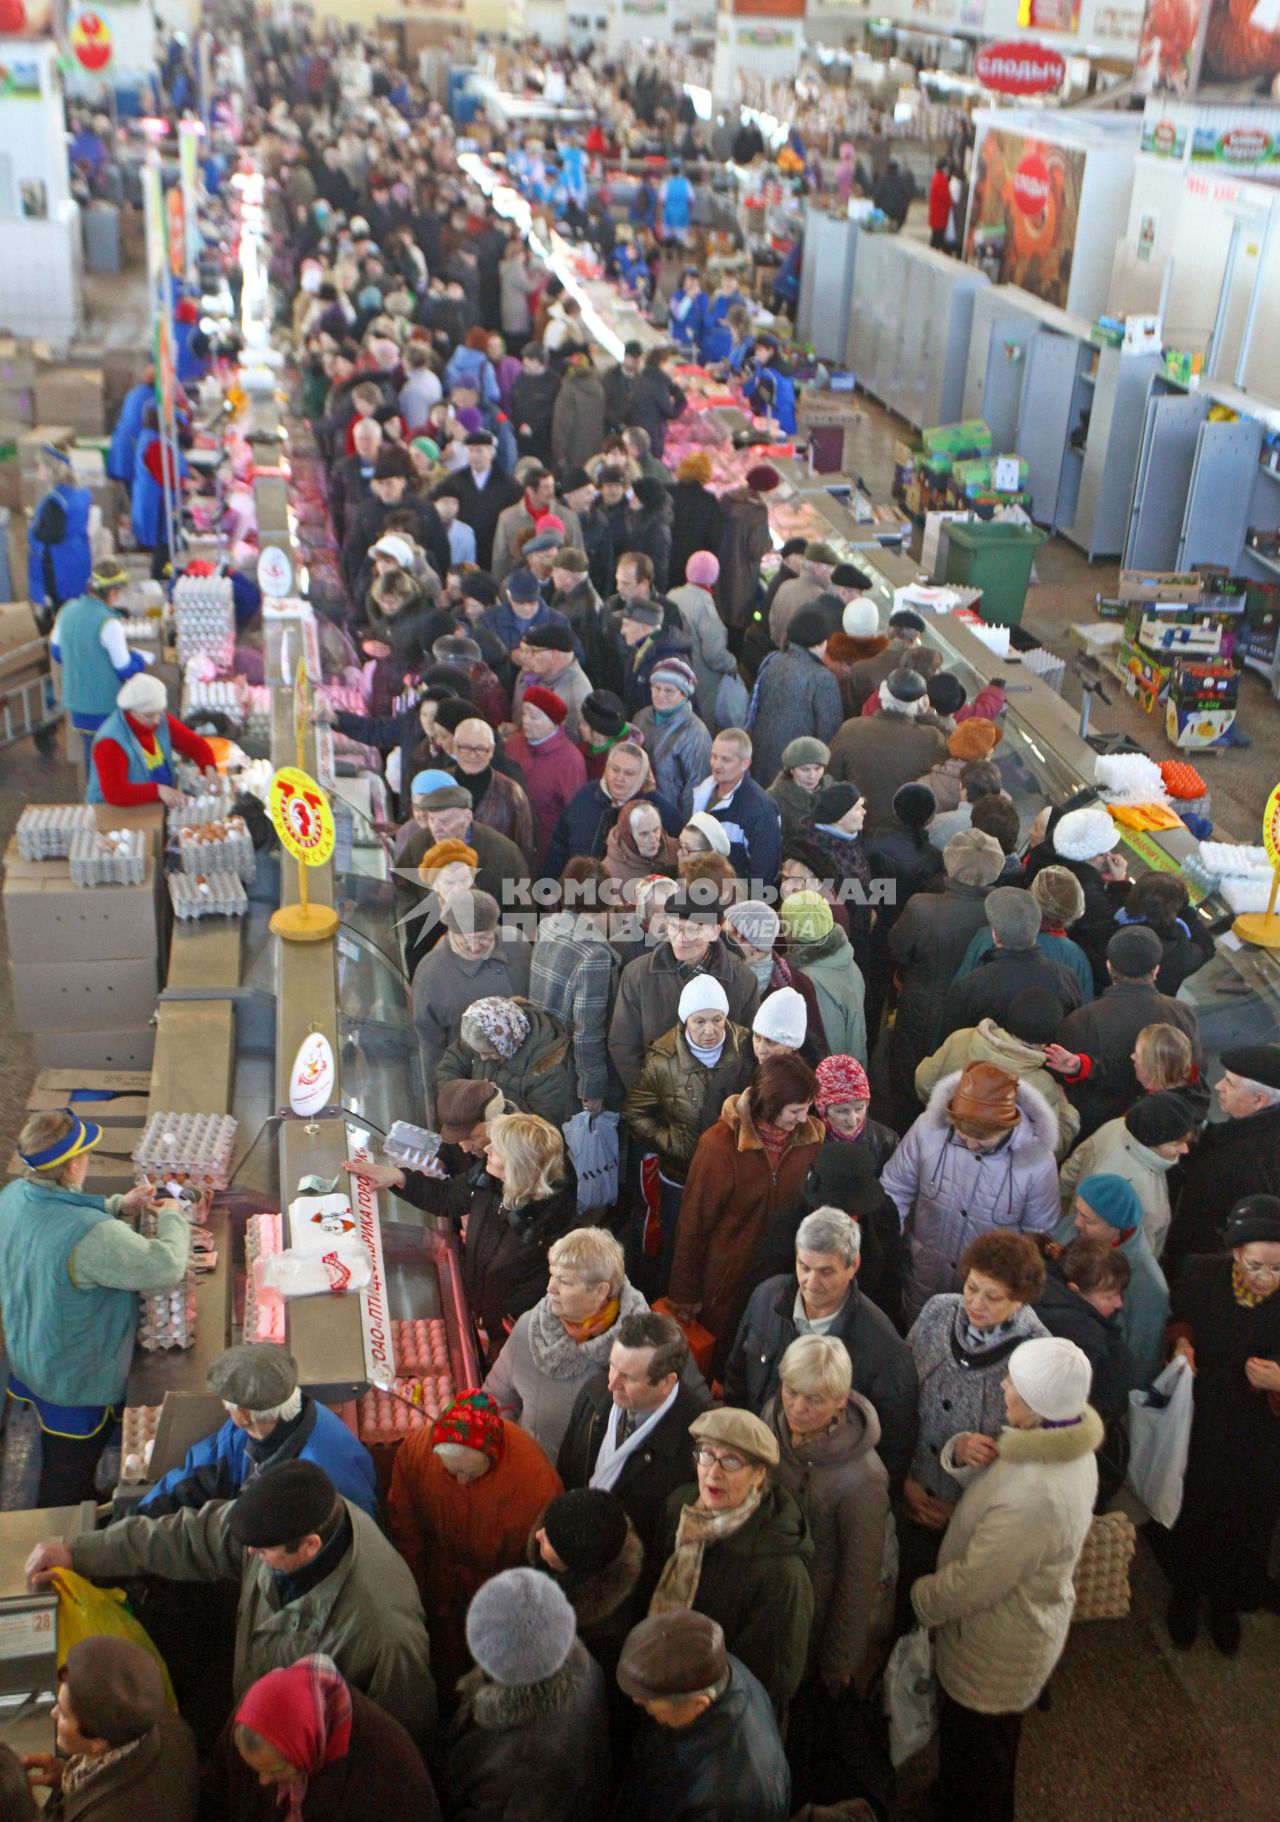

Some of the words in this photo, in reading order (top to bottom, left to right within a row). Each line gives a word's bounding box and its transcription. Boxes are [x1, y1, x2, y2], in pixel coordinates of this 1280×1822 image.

[977, 56, 1063, 84] СЛОДЫЧ
[370, 1328, 386, 1361] ОАО
[35, 1613, 51, 1633] 28
